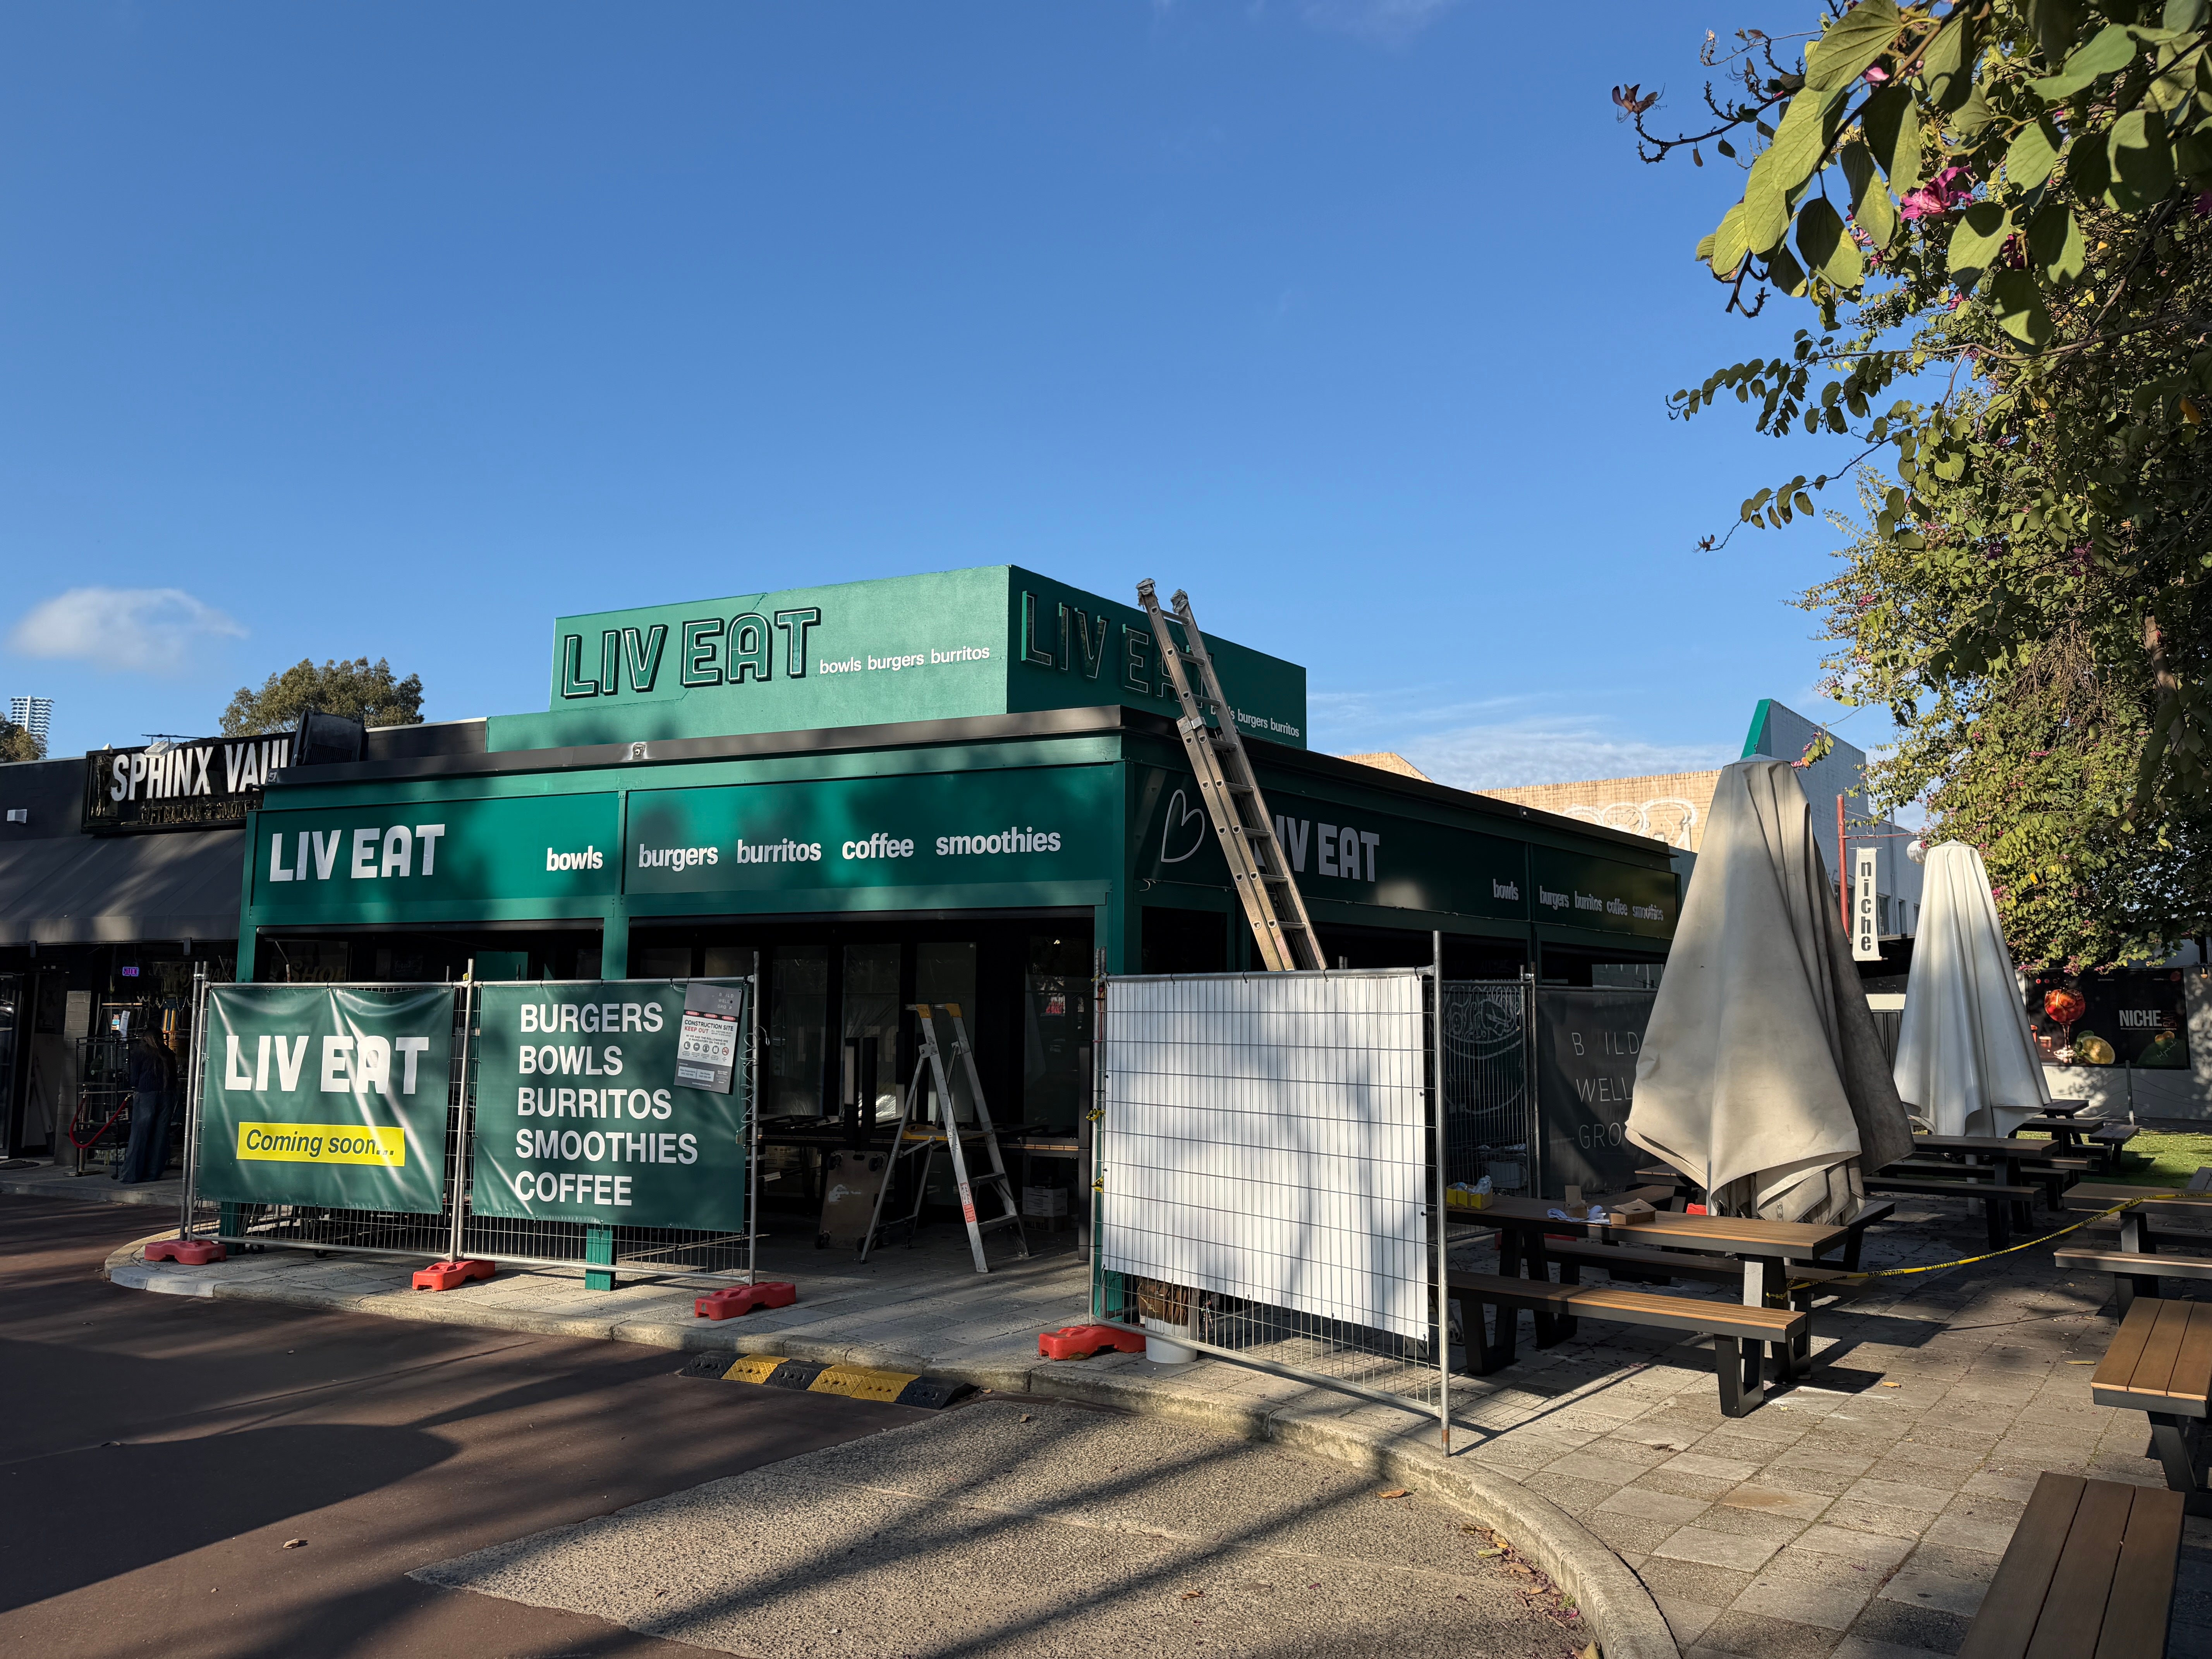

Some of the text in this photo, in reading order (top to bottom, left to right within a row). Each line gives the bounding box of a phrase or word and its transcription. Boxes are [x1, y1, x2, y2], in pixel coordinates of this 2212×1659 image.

[561, 607, 821, 699] LIV EAT
[1021, 591, 1110, 680] LIV
[819, 646, 990, 674] bowls burgers burritos
[1238, 709, 1268, 728] burgers
[1271, 718, 1299, 737] burritos
[111, 746, 214, 801] SPHINX
[270, 824, 445, 882] LIV EAT
[547, 826, 1061, 872] bowls burgers burritos coffee smoothies
[1318, 823, 1379, 882] EAT
[1493, 879, 1664, 921] bowls burgers burritos coffee smoothies
[1861, 861, 1872, 951] niche
[520, 1002, 663, 1033] BURGERS
[685, 1020, 722, 1030] CONSTRUCTION
[2119, 1010, 2162, 1027] NICHE
[225, 1036, 429, 1094] LIV EAT
[519, 1046, 623, 1075] BOWLS
[518, 1087, 672, 1120] BURRITOS
[1576, 1077, 1632, 1102] WELL
[246, 1129, 394, 1157] Coming soon...
[516, 1129, 698, 1164] SMOOTHIES
[1579, 1122, 1621, 1149] GRO
[515, 1171, 632, 1206] COFFEE
